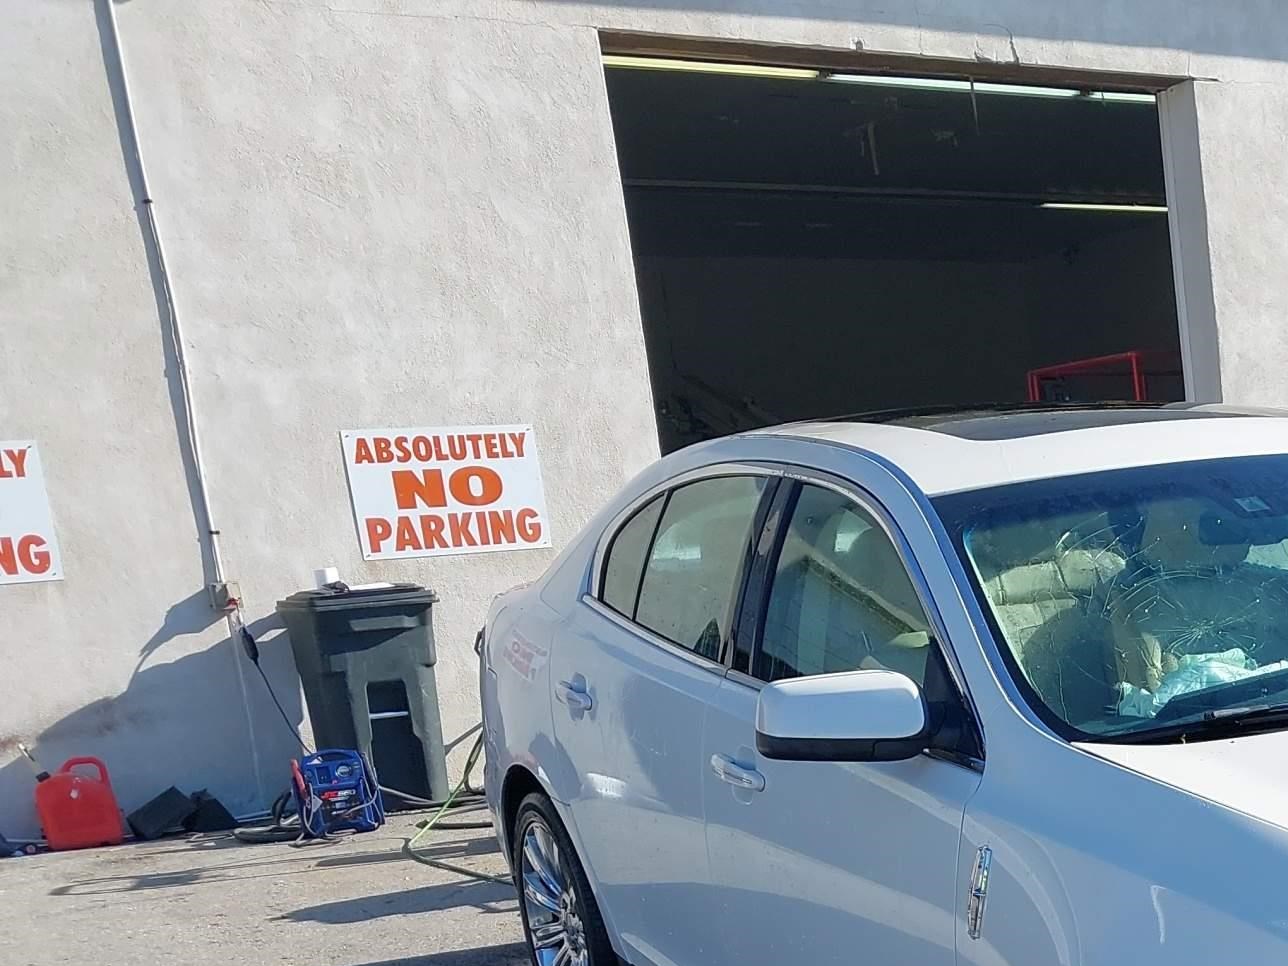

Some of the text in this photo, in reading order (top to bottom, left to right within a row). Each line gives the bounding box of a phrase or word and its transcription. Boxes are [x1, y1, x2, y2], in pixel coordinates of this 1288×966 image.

[354, 432, 526, 464] ABSOLUTELY
[391, 466, 503, 510] NO
[365, 508, 542, 553] PARKING
